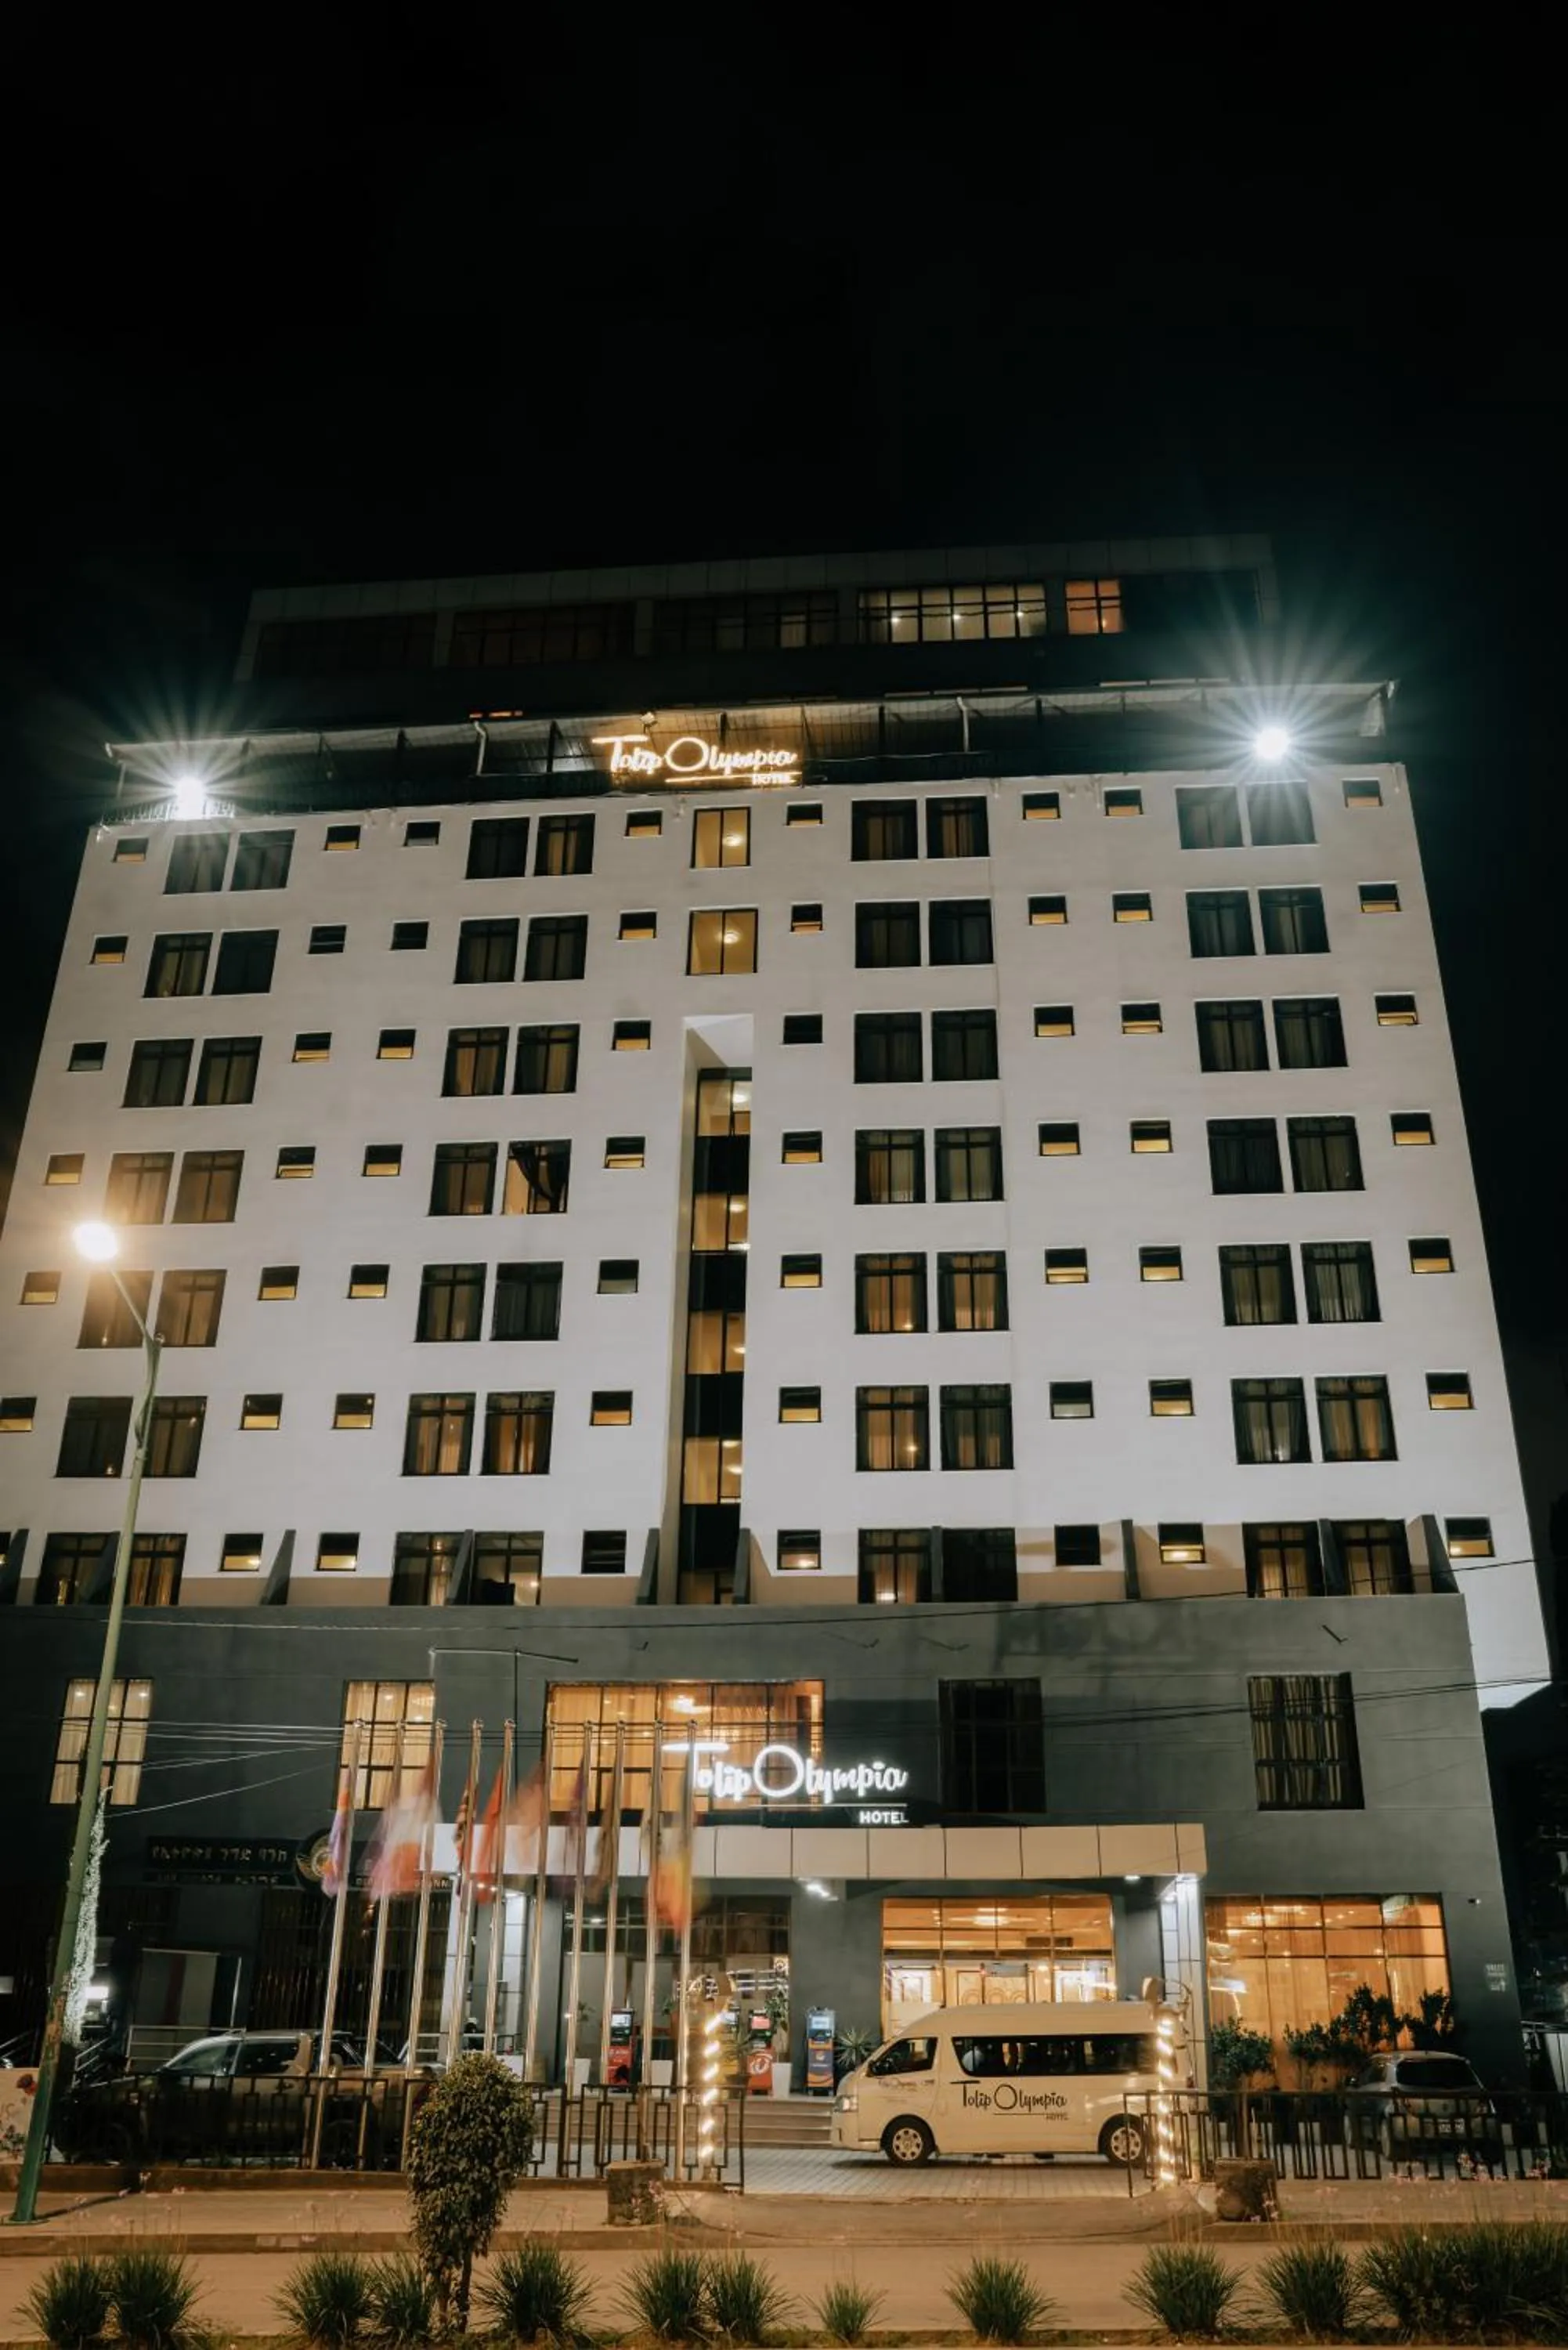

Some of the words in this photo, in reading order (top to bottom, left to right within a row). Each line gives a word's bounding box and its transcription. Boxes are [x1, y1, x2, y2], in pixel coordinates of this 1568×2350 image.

[665, 737, 797, 776] Olympia
[662, 1742, 751, 1801] Tolip
[753, 1744, 909, 1803] Olympia
[859, 1810, 909, 1824] HOTEL
[950, 2081, 992, 2110] Tolip
[993, 2084, 1068, 2113] Olympia
